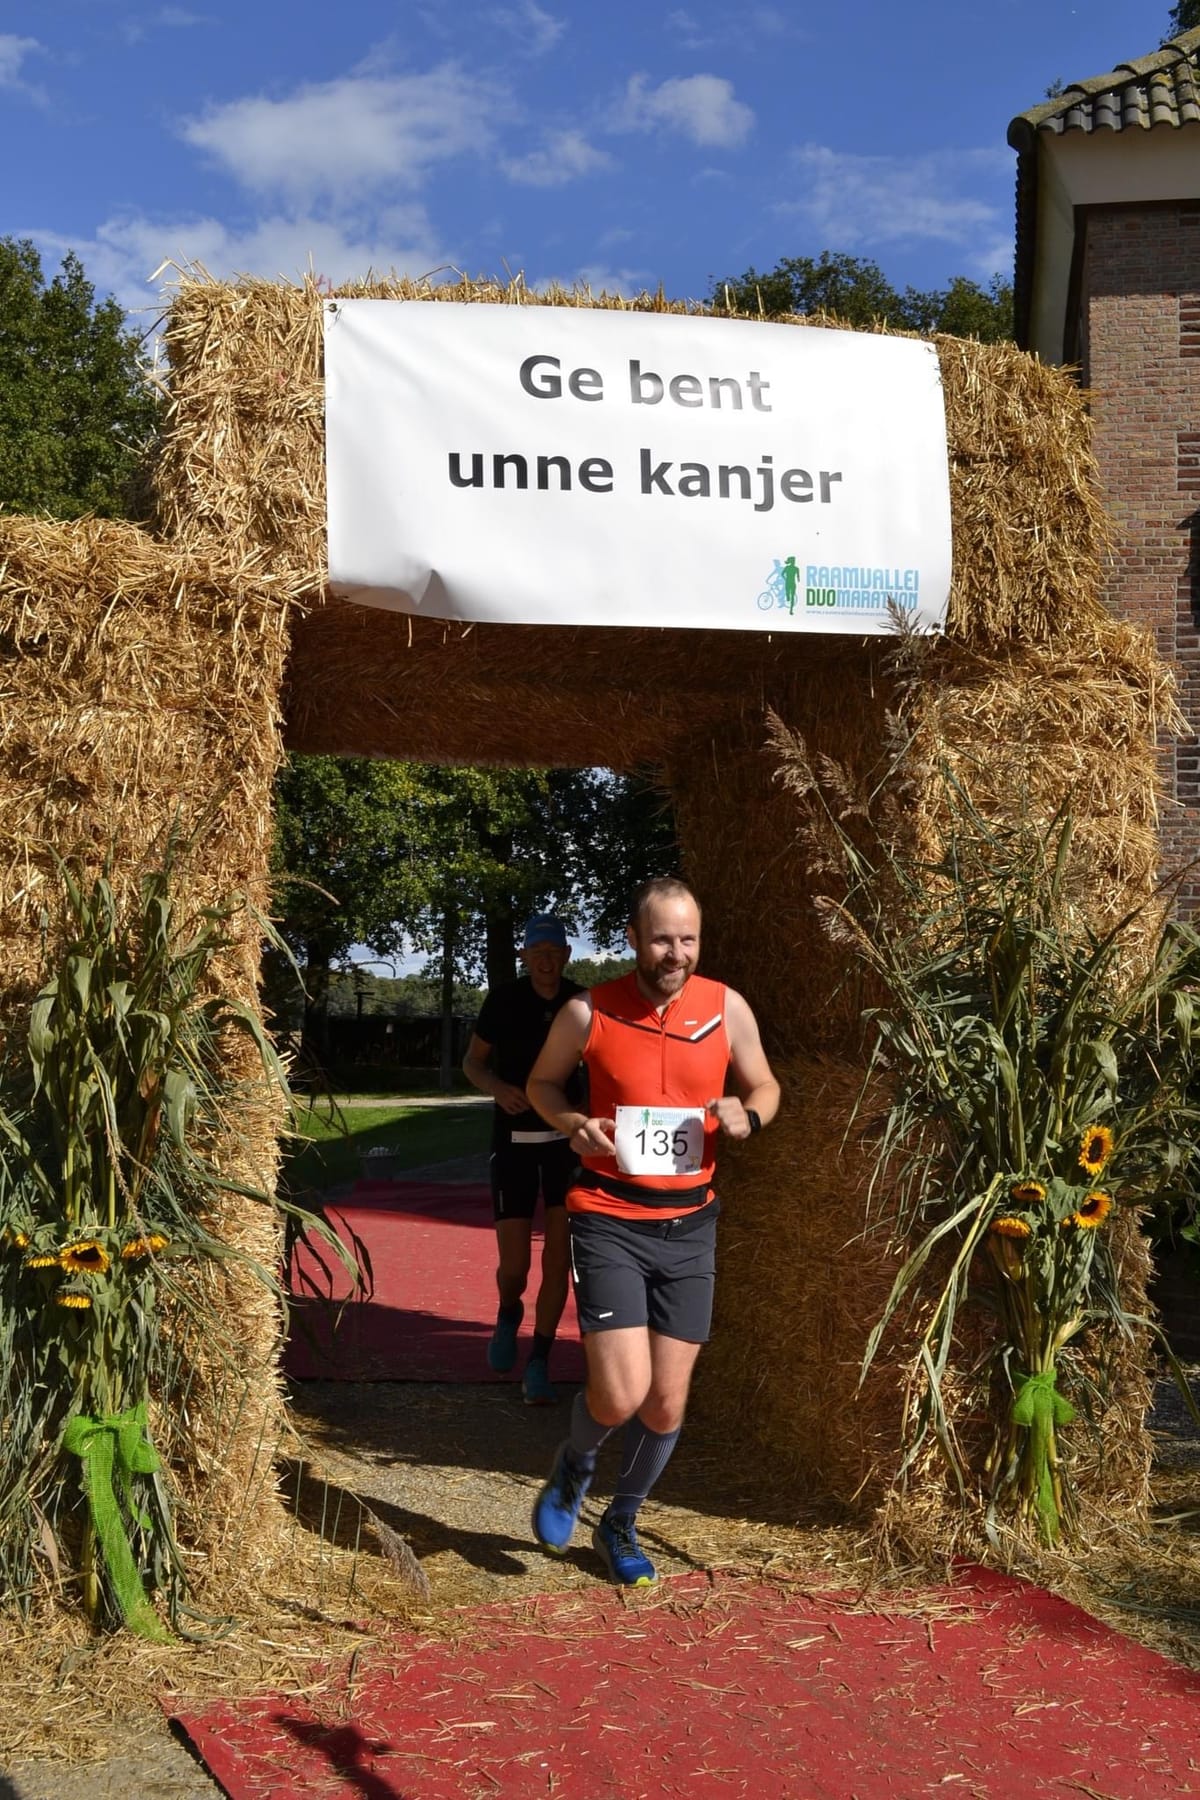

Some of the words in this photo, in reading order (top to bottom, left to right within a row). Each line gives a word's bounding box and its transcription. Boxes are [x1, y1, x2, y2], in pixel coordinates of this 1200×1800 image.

[519, 354, 604, 401] Ge
[629, 360, 772, 412] bent
[448, 452, 614, 493] unne
[640, 448, 842, 512] kanjer
[806, 565, 919, 591] RAAMVALLEI
[635, 1129, 688, 1156] 135
